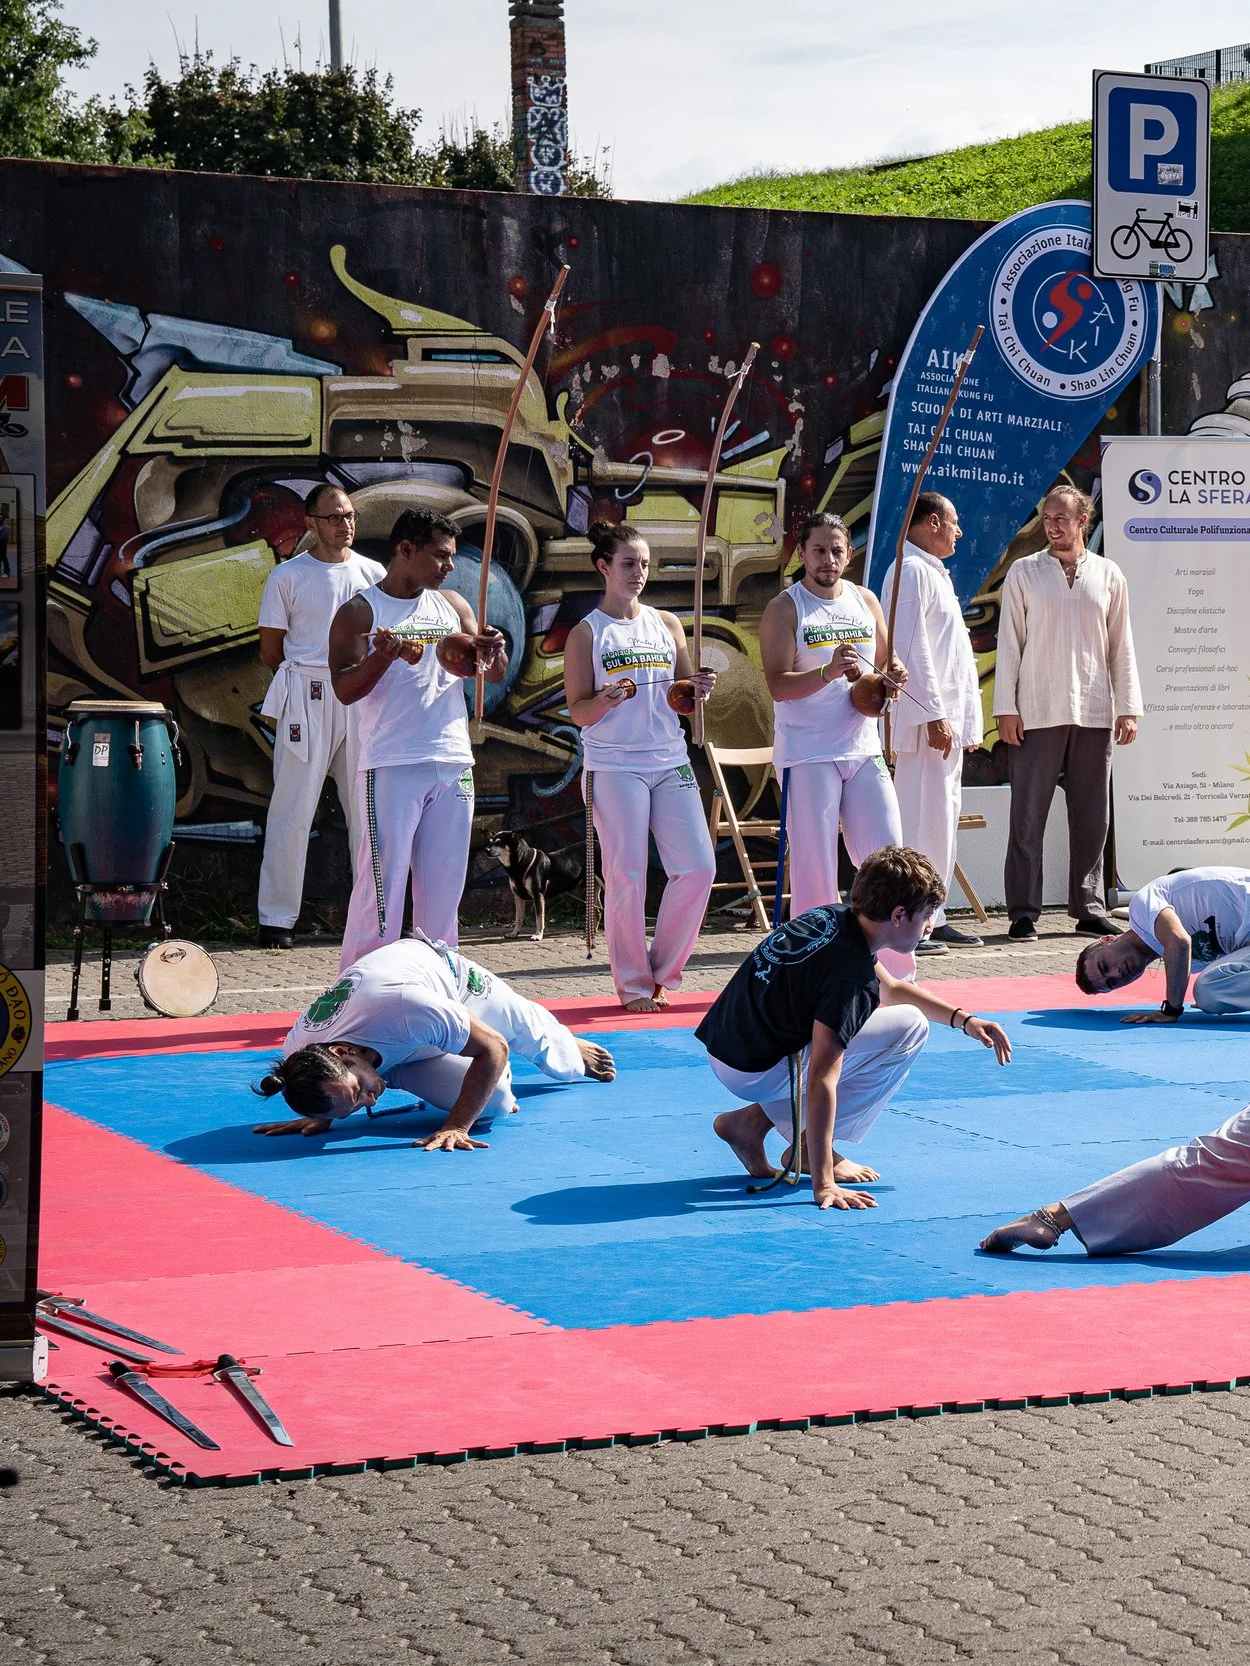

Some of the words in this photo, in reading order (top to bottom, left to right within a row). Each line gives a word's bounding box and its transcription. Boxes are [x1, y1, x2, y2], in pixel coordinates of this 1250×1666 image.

[1129, 103, 1179, 180] P
[1001, 235, 1062, 292] Associazione
[1066, 234, 1092, 251] Itali
[1121, 279, 1133, 293] ng
[1128, 296, 1140, 312] Fu
[998, 312, 1009, 331] Tai
[1004, 336, 1020, 358] Chi
[1018, 357, 1051, 387] Chuan
[1070, 378, 1097, 392] Shao
[1098, 365, 1117, 383] Lin
[1115, 333, 1138, 367] Chuan
[920, 372, 979, 387] ASSOCIAONE
[984, 393, 994, 402] FU
[960, 408, 972, 419] DI
[976, 410, 1002, 423] ARTI
[1007, 414, 1062, 432] MARZIALI
[908, 423, 926, 435] TAI
[954, 428, 993, 443] CHUAN
[957, 446, 995, 460] CHUAN
[1168, 470, 1246, 486] CENTRO
[1169, 489, 1191, 504] LA
[1129, 526, 1158, 534] Centro
[1160, 524, 1199, 534] Culturale
[1175, 568, 1188, 576] Arti
[1190, 568, 1216, 576] marziali
[1187, 588, 1204, 598] Yoga
[1166, 607, 1197, 616] Discipline
[1198, 607, 1226, 615] olistiche
[1174, 626, 1196, 634] Mostre
[1198, 626, 1218, 634] d'arte
[808, 634, 824, 644] SUL
[826, 632, 838, 641] DA
[838, 630, 864, 639] BAHIA
[1168, 646, 1196, 656] Convegni
[1198, 646, 1226, 655] filosofici
[606, 658, 624, 670] SUL
[625, 656, 638, 664] DA
[640, 654, 664, 663] BAHIA
[1156, 665, 1173, 673] Corsi
[1174, 665, 1216, 674] professionali
[1165, 684, 1208, 692] Presentazioni
[1210, 684, 1216, 692] di
[1217, 684, 1230, 692] libri
[1143, 704, 1165, 714] Affitto
[1166, 704, 1178, 712] sale
[1179, 704, 1216, 714] conferenze
[1210, 722, 1234, 730] ancora!
[1176, 782, 1199, 790] Asiago,
[1128, 794, 1140, 802] Via
[1196, 792, 1228, 800] Torricella
